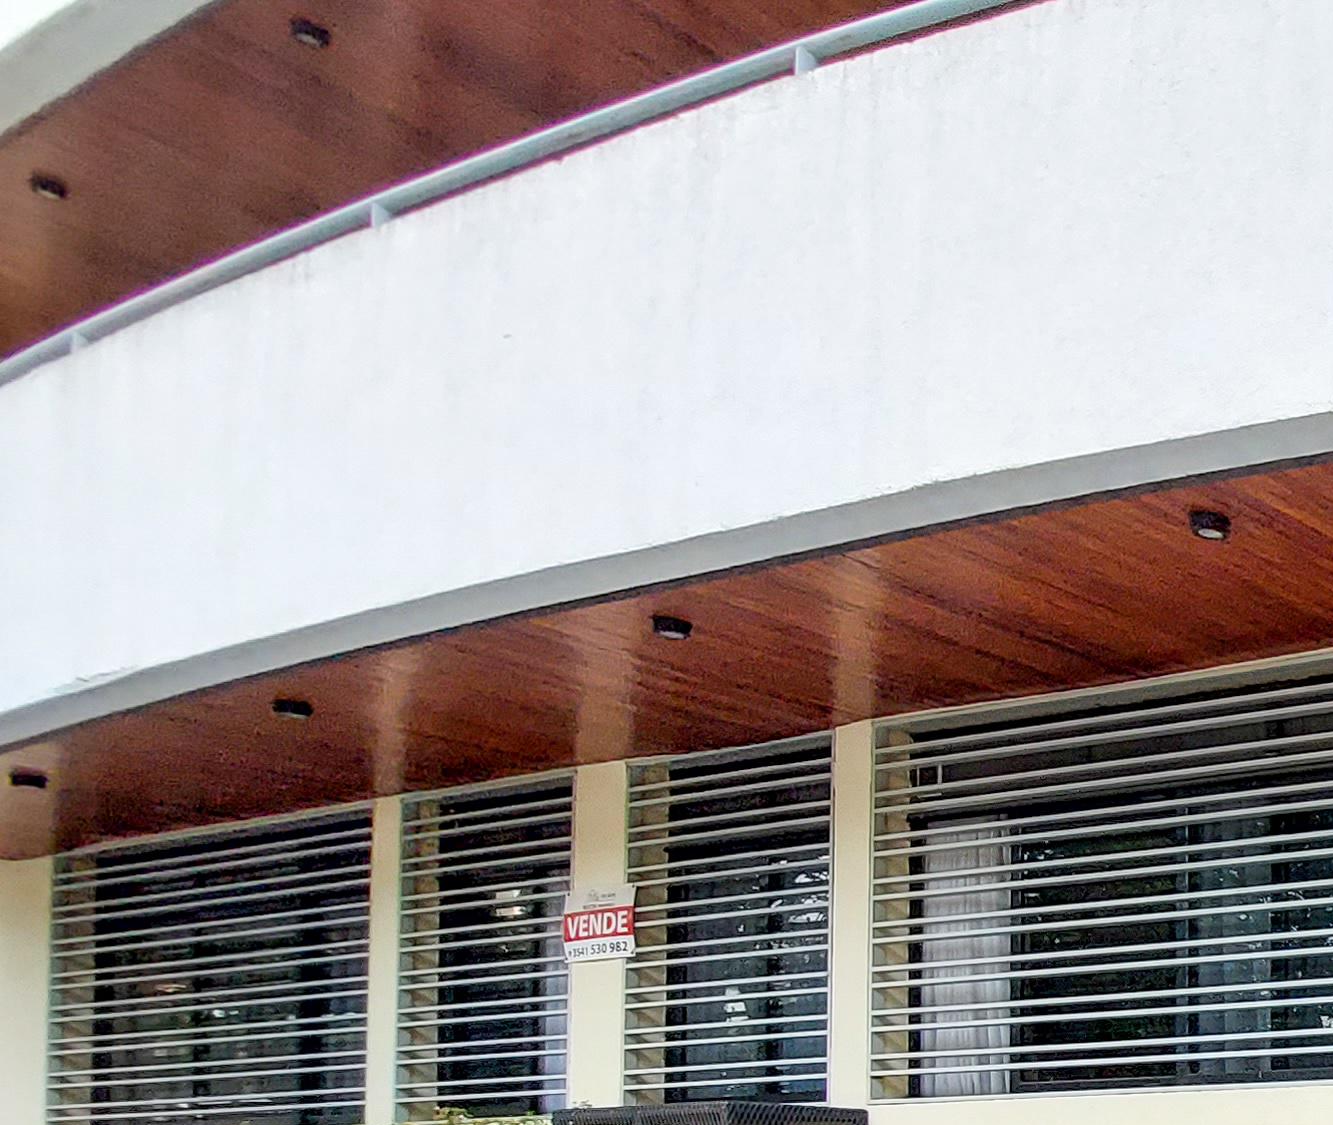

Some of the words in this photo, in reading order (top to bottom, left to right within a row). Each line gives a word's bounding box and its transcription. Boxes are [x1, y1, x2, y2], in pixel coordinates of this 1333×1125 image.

[566, 910, 629, 939] VENDE
[590, 943, 607, 955] 530
[609, 940, 629, 952] 982
